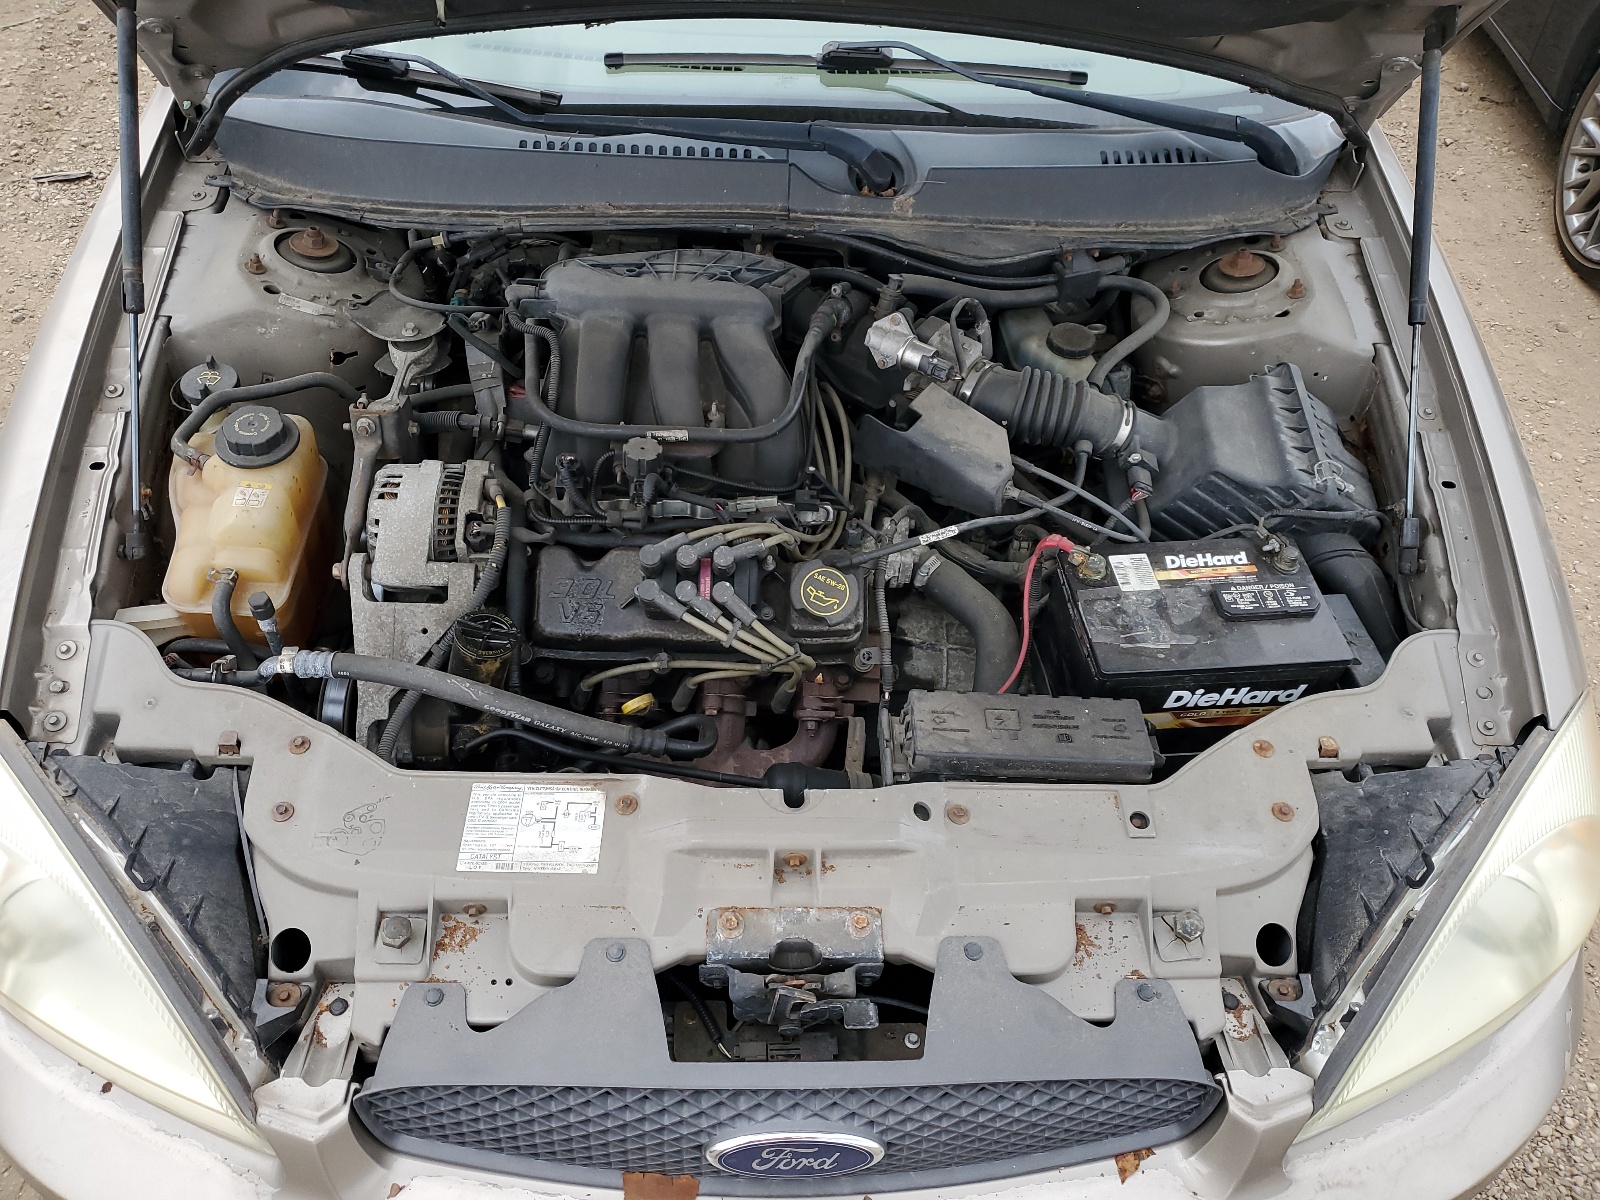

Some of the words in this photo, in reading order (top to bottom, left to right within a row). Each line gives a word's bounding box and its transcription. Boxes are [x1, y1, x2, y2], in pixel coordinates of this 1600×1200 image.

[1164, 551, 1249, 569] DieHard
[813, 573, 826, 583] SAE
[826, 578, 846, 591] 5W-20
[1163, 684, 1309, 709] DieHard
[483, 704, 532, 723] GOODYEAR
[534, 719, 568, 734] GALAXY
[752, 1147, 841, 1171] Ford
